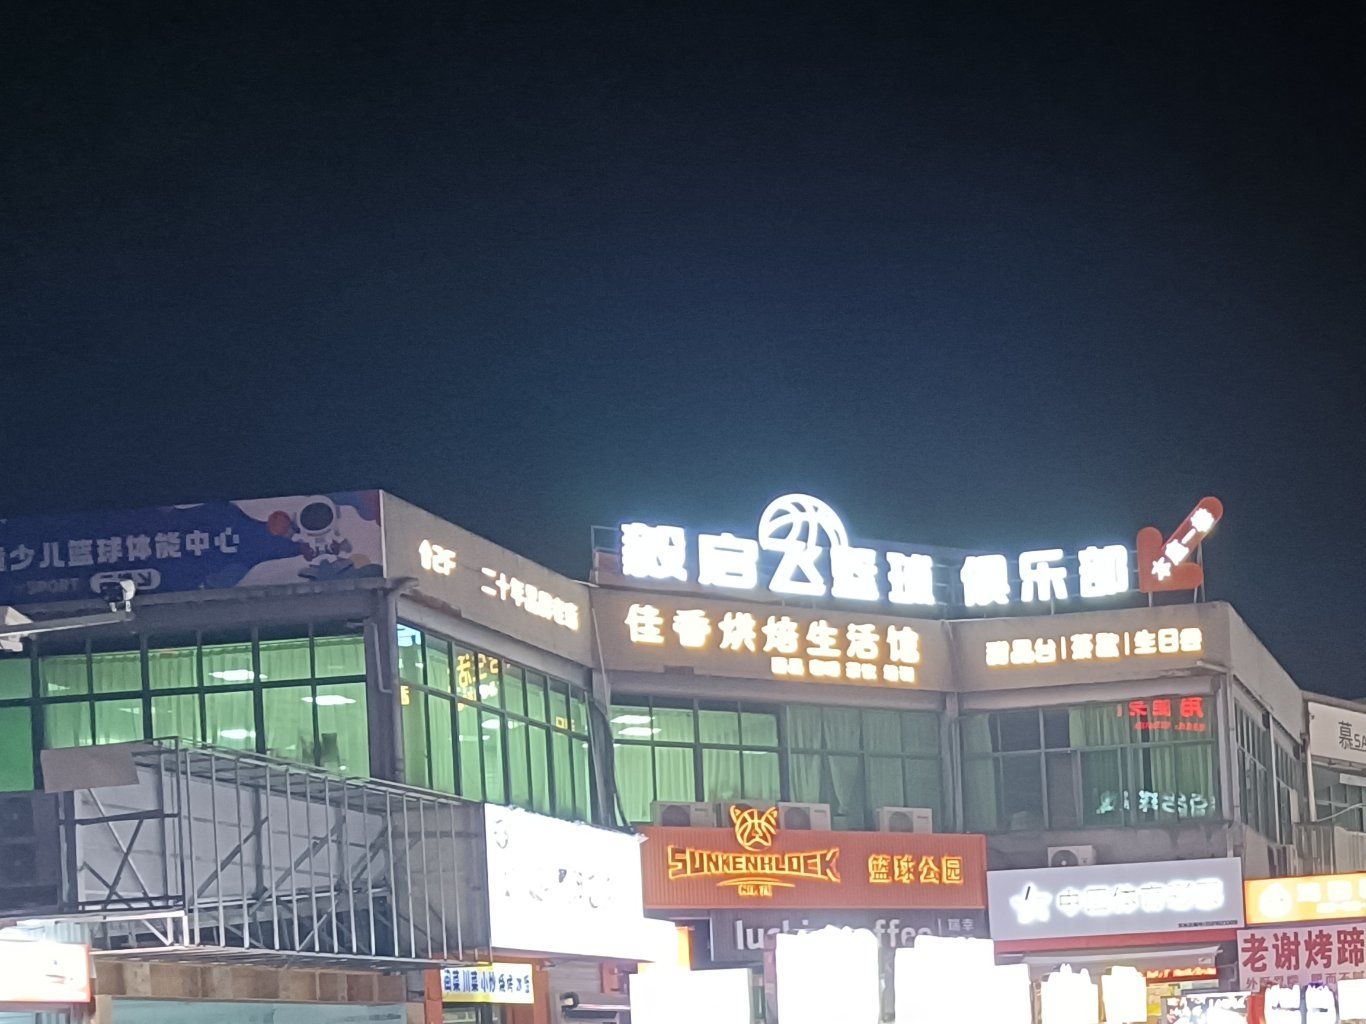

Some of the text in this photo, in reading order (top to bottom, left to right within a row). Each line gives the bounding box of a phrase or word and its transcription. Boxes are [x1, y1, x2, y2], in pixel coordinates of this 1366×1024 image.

[960, 544, 1129, 607] 俱乐部
[625, 603, 921, 664] 佳香烘焙生活馆
[867, 853, 965, 885] 篮球公园
[1241, 926, 1365, 973] 老谢烤蹄
